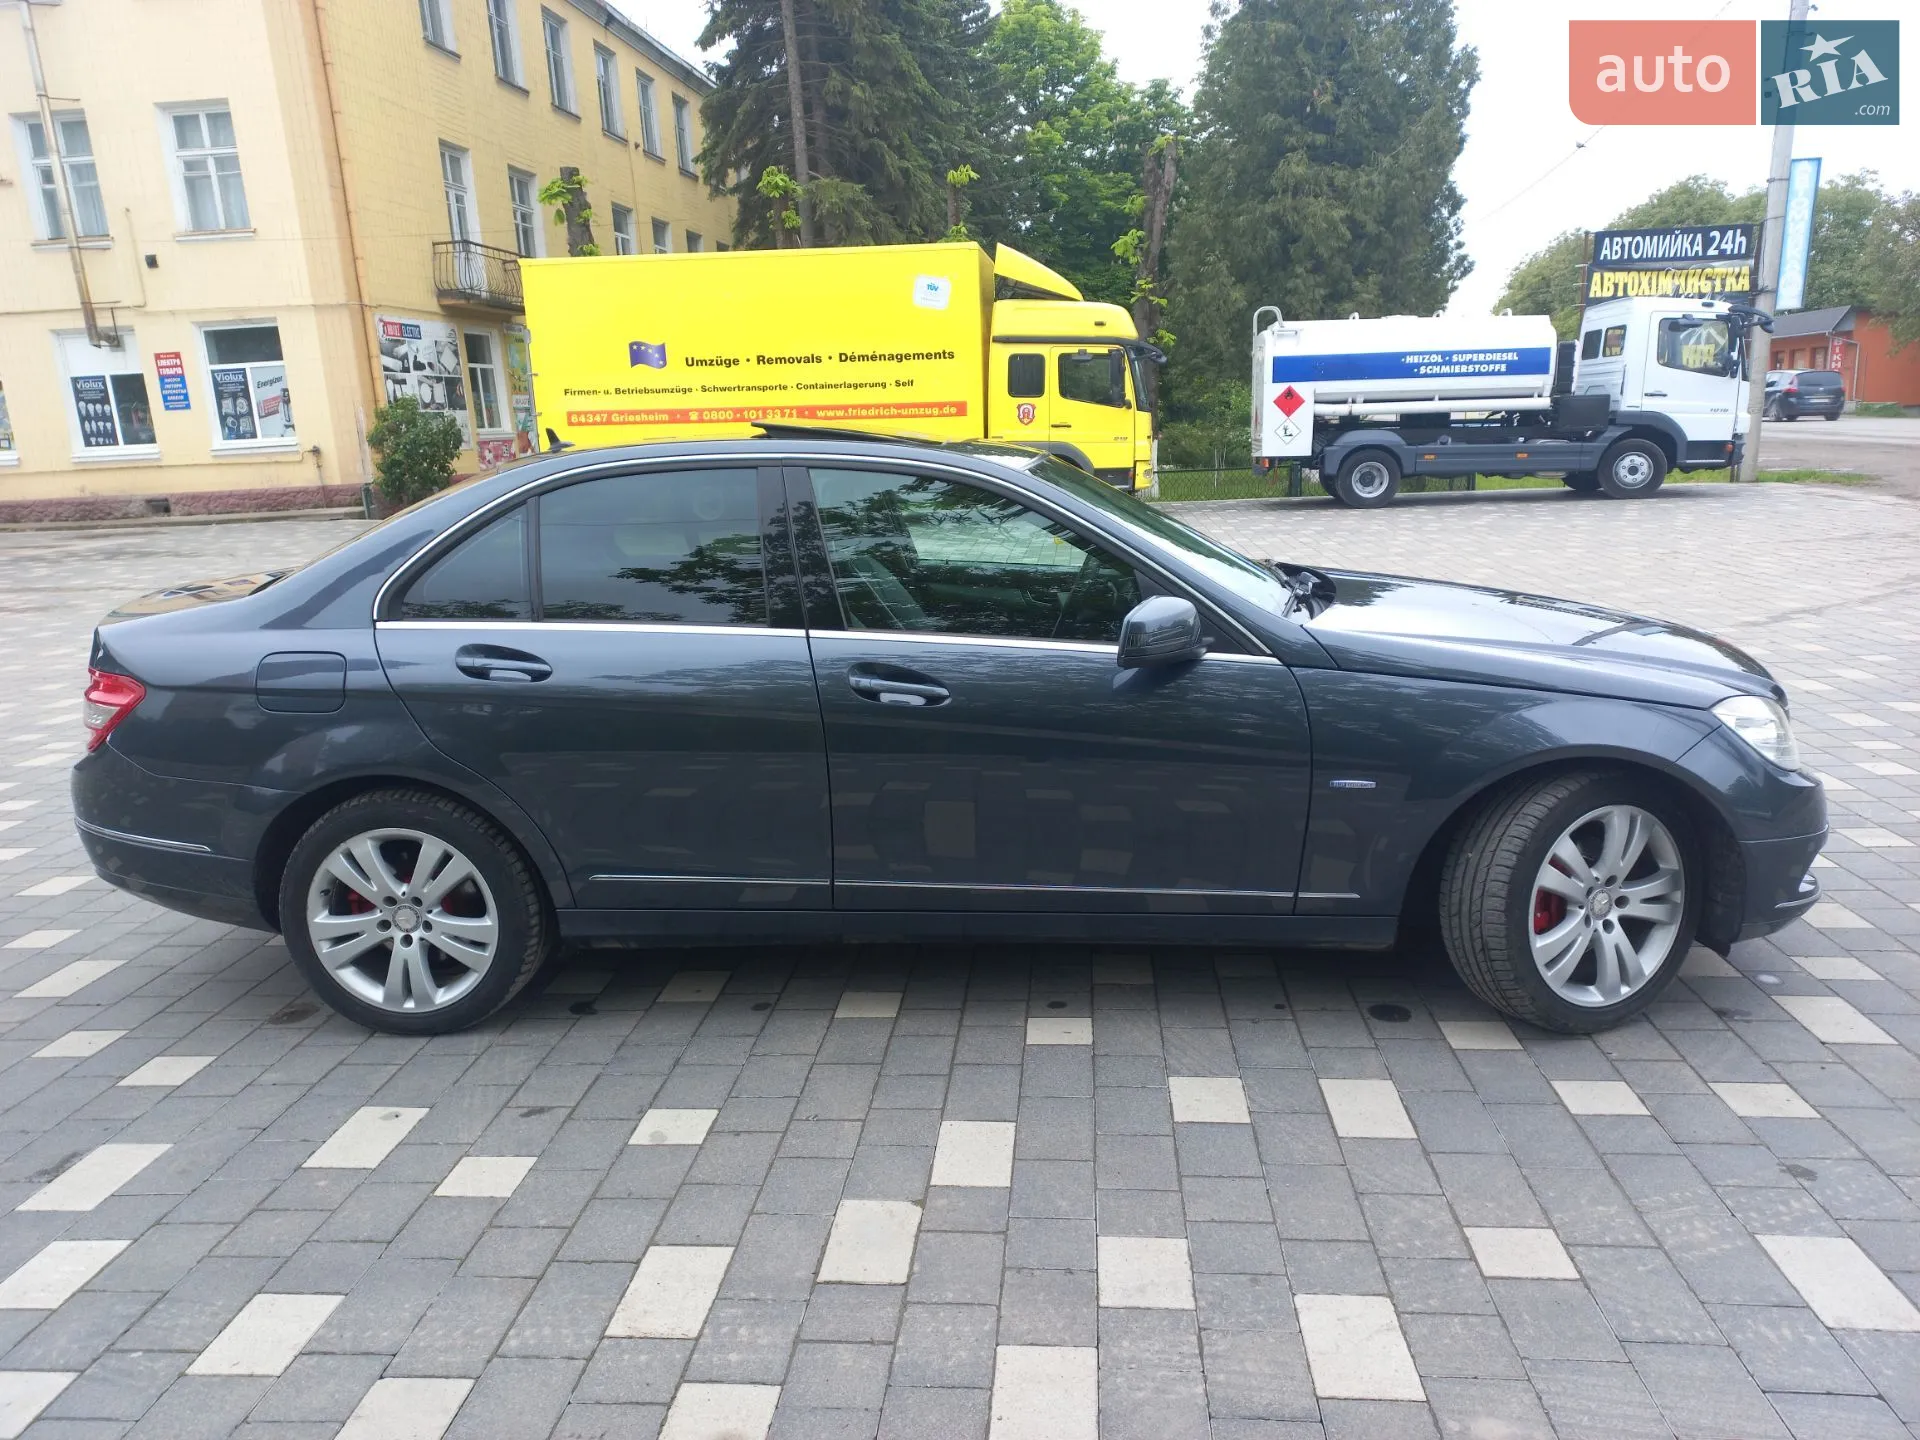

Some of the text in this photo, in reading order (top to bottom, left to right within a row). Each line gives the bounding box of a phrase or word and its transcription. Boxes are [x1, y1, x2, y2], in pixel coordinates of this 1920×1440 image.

[1600, 228, 1747, 261] АВТОМИЙКА 24h
[685, 349, 955, 369] Umzüge Removals Déménagements
[1405, 351, 1519, 364] HEIZÖL SUPERDIESEL
[1419, 363, 1507, 374] SCHMIERSTOFFE
[214, 371, 245, 382] Violux
[76, 380, 105, 390] Violux
[563, 387, 602, 397] Firmen-
[614, 385, 693, 396] Betriebsumzüge
[700, 383, 789, 394] Schwertransporte
[795, 380, 887, 391] Containerlagerung
[611, 411, 670, 423] Griesheim
[702, 410, 734, 420] 0800
[816, 404, 957, 418] www.friedrich-umzug.de
